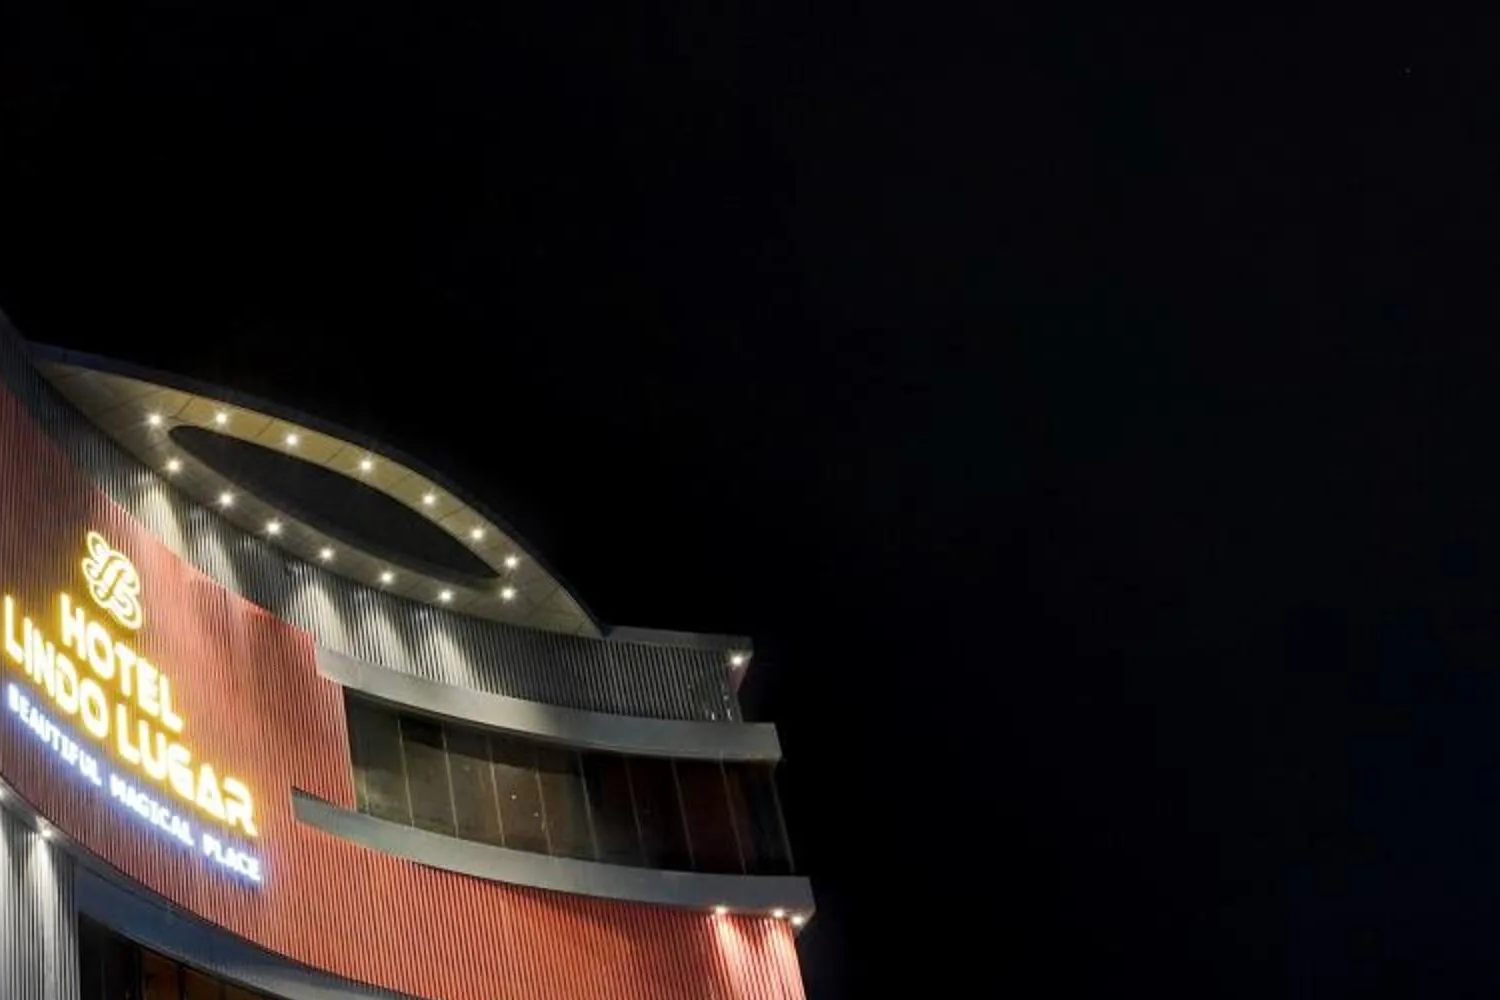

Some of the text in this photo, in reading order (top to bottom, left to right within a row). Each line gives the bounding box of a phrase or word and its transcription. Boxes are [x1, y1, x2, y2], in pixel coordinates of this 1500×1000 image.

[4, 595, 258, 837] LINDO LUGAR
[60, 592, 182, 732] HOTEL
[8, 683, 260, 881] BEAUTIFUL MAGICAL PLACE
